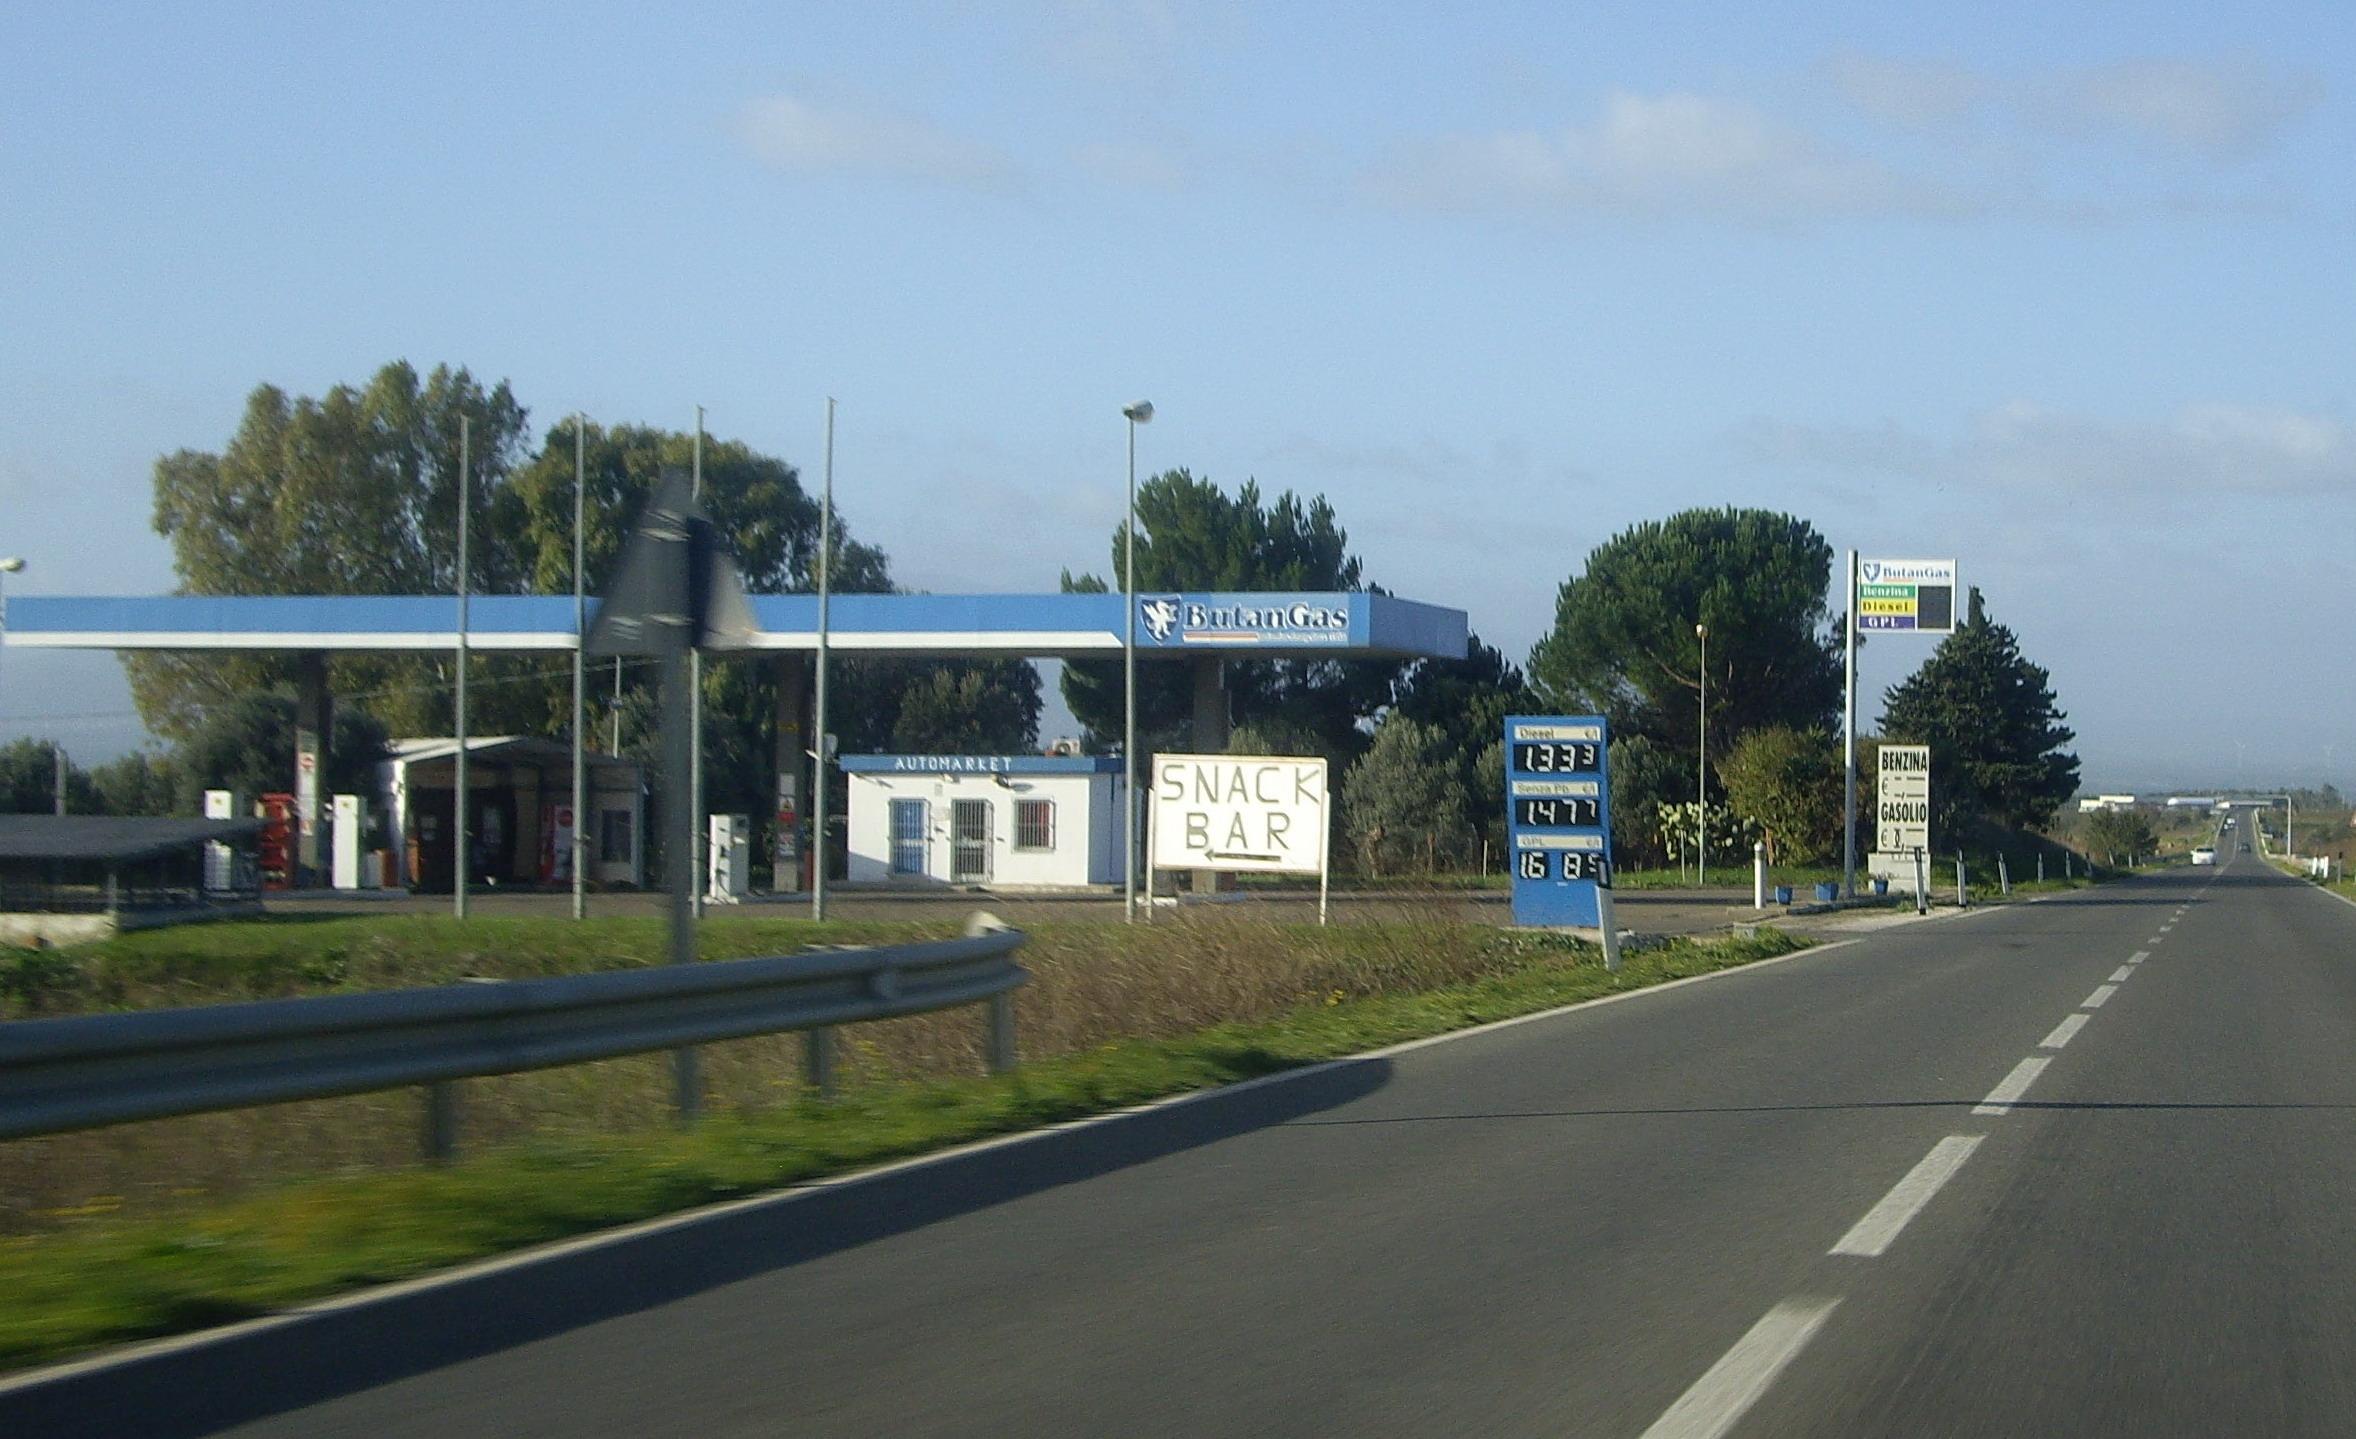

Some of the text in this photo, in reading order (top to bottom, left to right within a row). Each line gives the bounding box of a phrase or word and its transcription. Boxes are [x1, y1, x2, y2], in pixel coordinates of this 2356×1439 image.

[1883, 567, 1950, 578] ButanGas
[1863, 586, 1909, 596] Benzina
[1863, 601, 1909, 612] Diesel
[1184, 602, 1349, 630] ButanGas
[1868, 617, 1899, 628] GPL
[1520, 727, 1554, 738] Diesel
[896, 757, 1012, 771] AUTOMARKET
[1882, 751, 1928, 771] BENZINA
[1162, 765, 1320, 804] SNACK
[1881, 802, 1927, 823] GASOLIO
[1186, 811, 1290, 850] BAR
